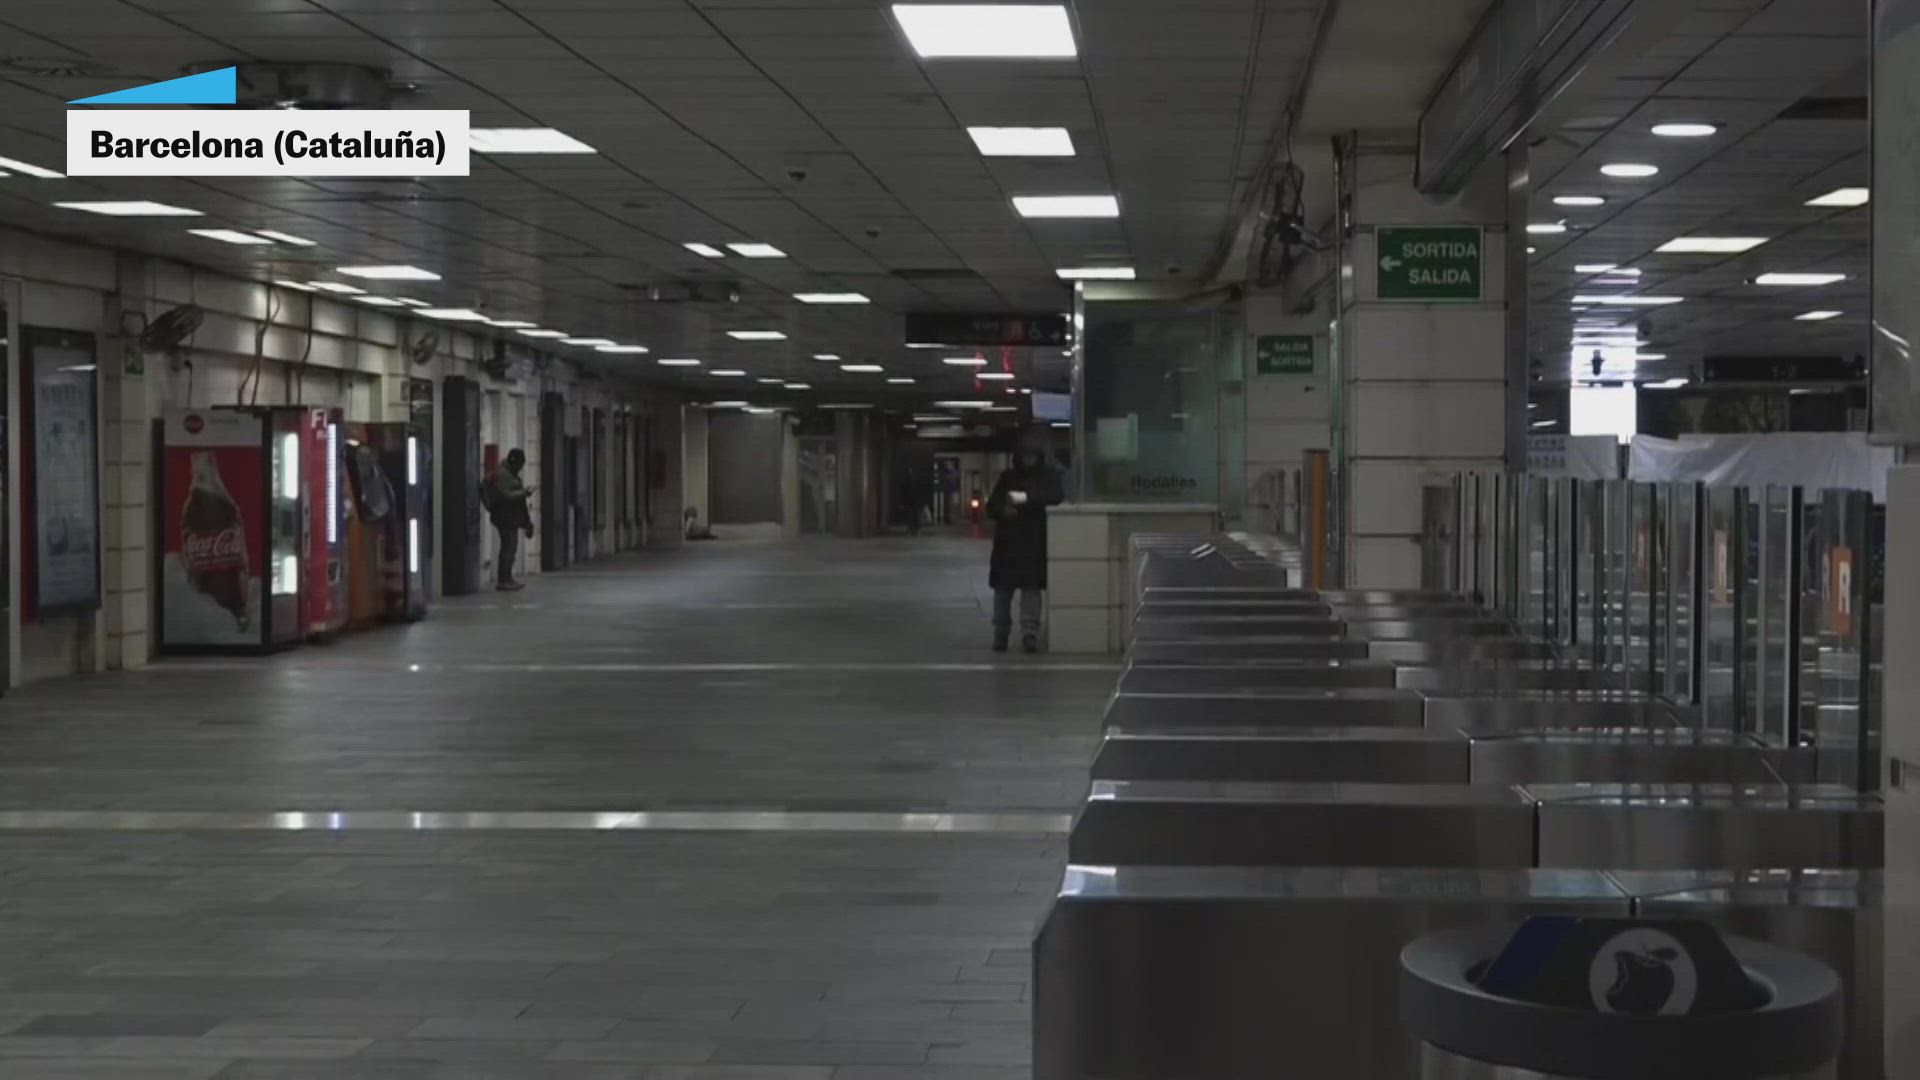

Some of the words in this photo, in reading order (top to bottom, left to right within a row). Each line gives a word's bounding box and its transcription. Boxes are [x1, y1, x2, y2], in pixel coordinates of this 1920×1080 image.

[1401, 242, 1478, 259] SORTIDA
[1408, 268, 1472, 284] SALIDA
[1273, 342, 1309, 353] SALIDA
[1270, 356, 1312, 367] SORTIDA
[1131, 475, 1197, 489] Rodalies
[185, 528, 243, 559] Coca-Cola
